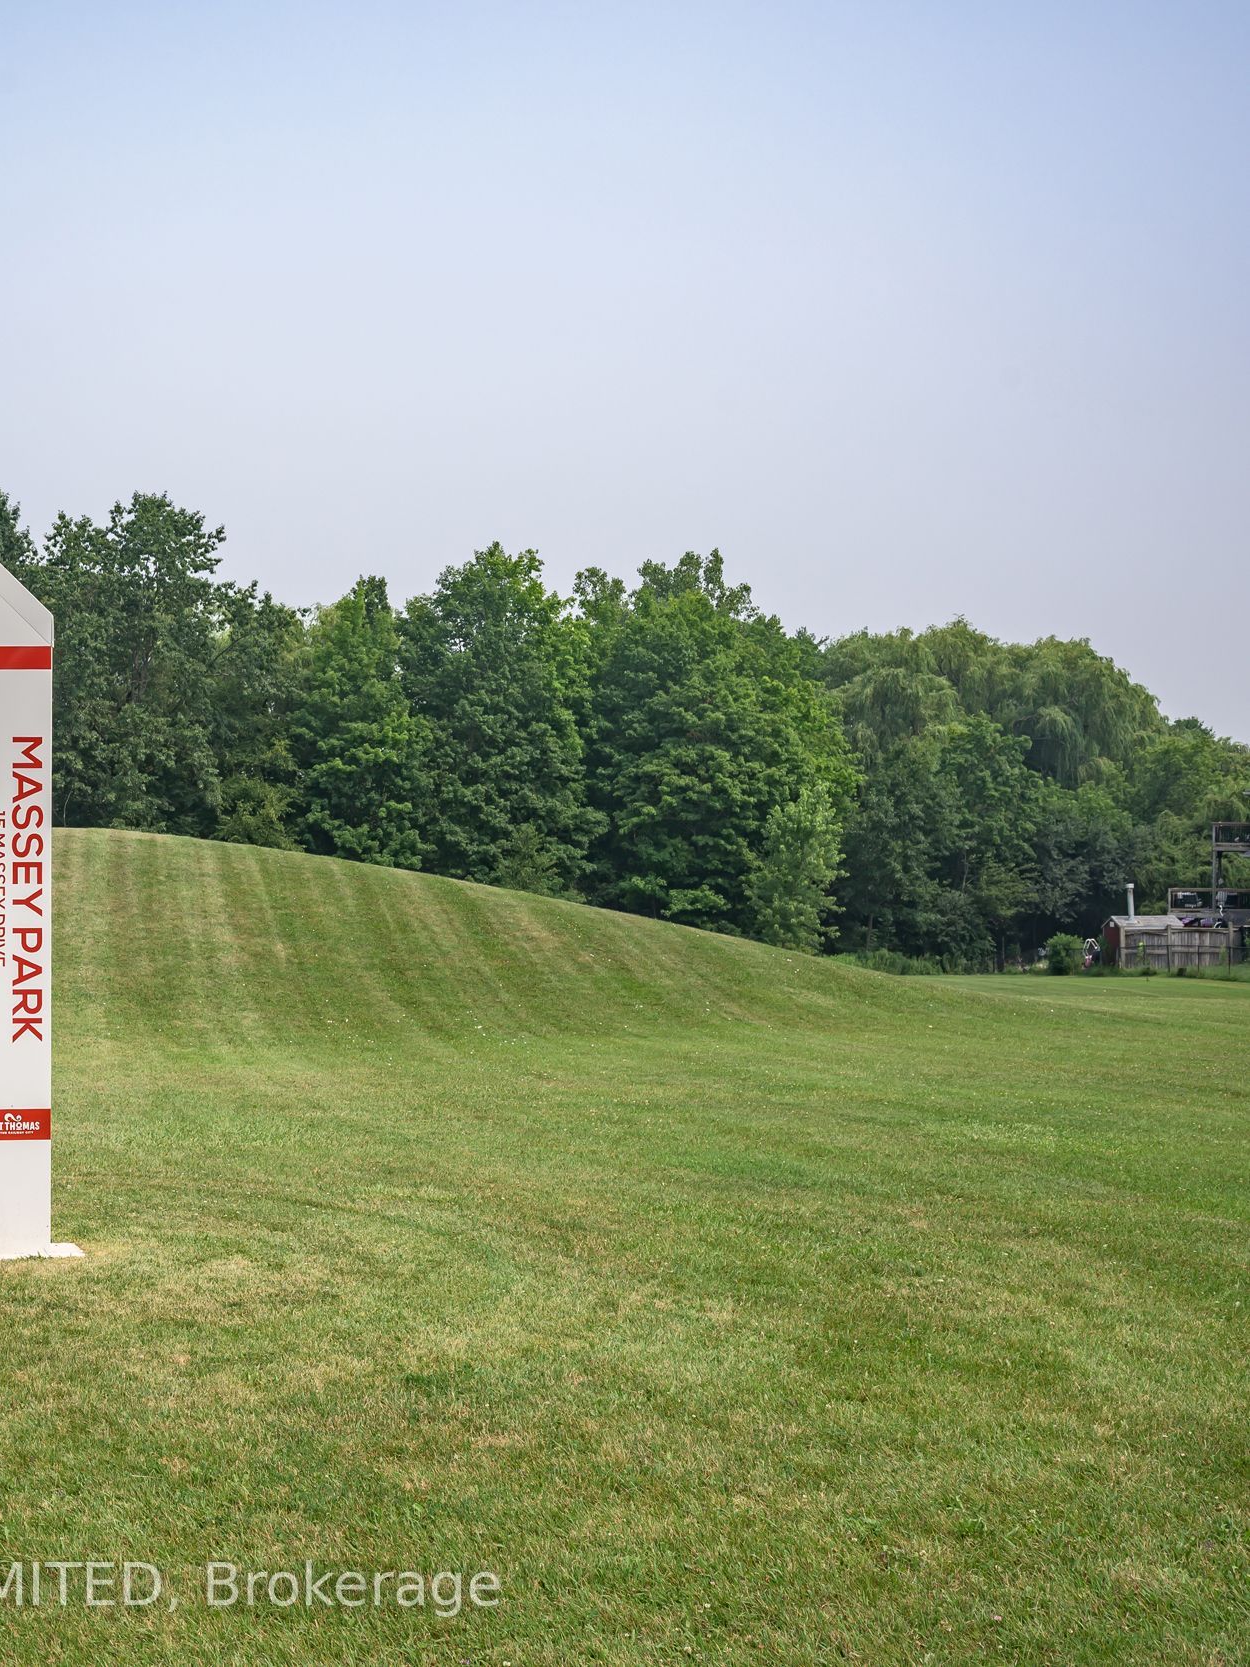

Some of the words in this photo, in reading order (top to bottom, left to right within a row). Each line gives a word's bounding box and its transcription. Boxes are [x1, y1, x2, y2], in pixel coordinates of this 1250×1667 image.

[12, 737, 44, 917] MASSEY
[12, 928, 43, 1043] PARK
[4, 1121, 40, 1131] THOMAS
